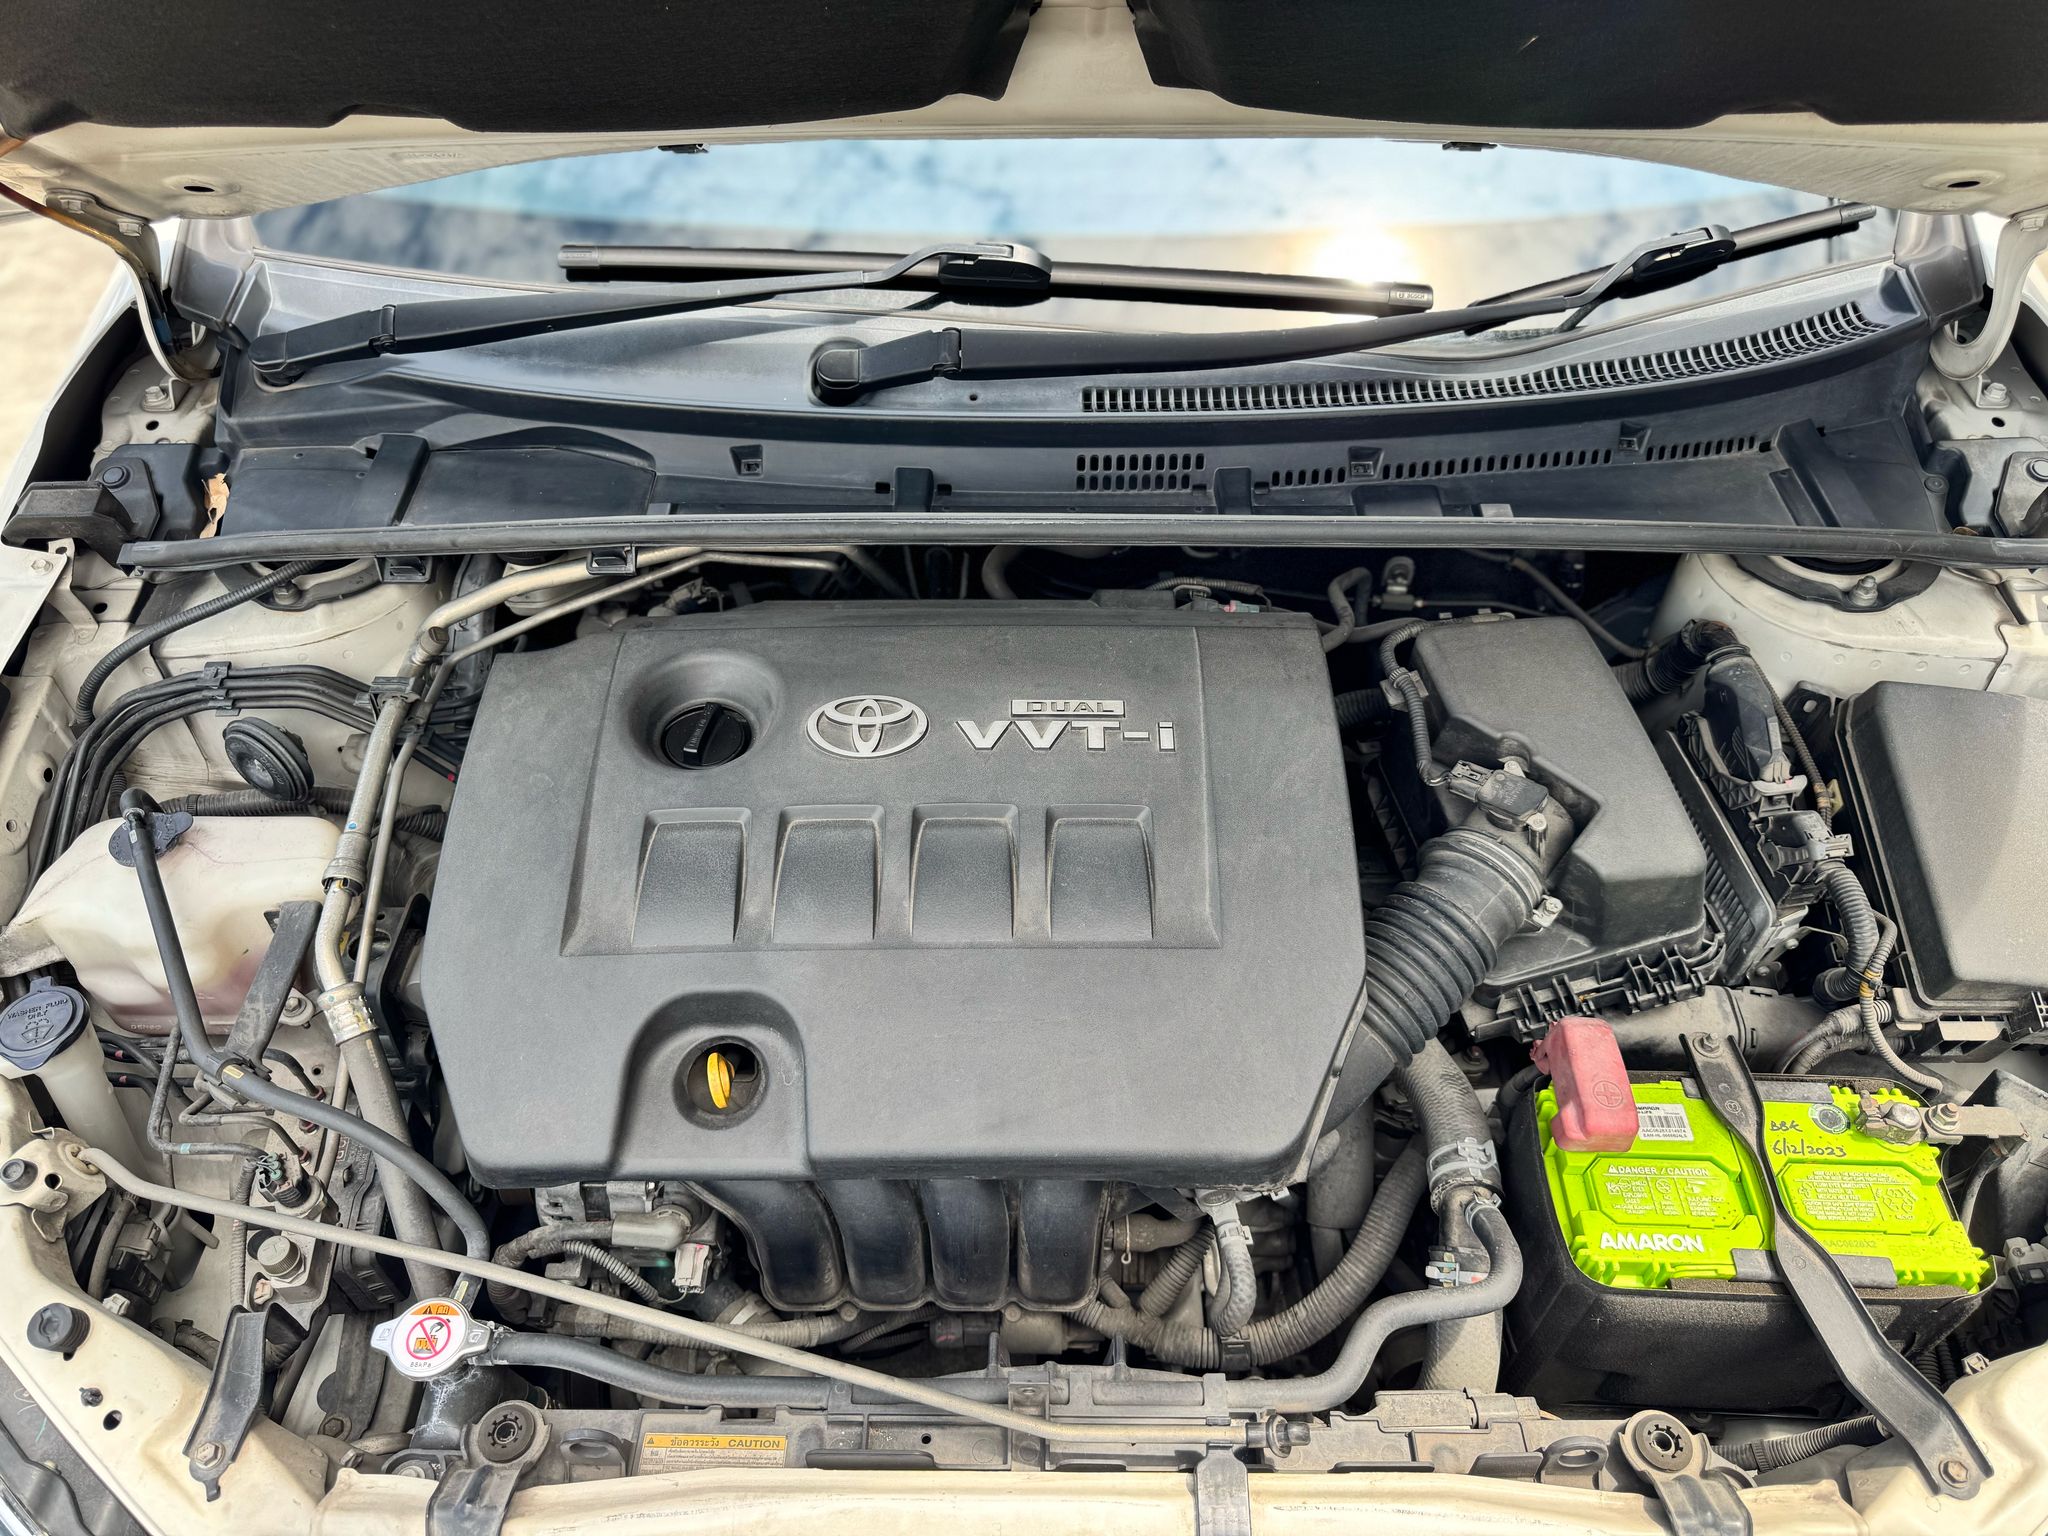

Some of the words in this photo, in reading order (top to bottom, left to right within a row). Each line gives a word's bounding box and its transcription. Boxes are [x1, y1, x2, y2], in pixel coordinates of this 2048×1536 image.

[1026, 701, 1115, 713] DUAL
[955, 720, 1175, 751] VVT-i
[7, 1006, 42, 1020] WASHER
[27, 1009, 49, 1020] ONLY
[1773, 1137, 1847, 1158] 6/12/2023
[1617, 1165, 1658, 1175] DANGER
[1667, 1167, 1709, 1177] CAUTION
[1600, 1231, 1705, 1253] AMARON
[670, 1436, 720, 1448] ข้อควรระวัง
[727, 1439, 781, 1449] CAUTION
